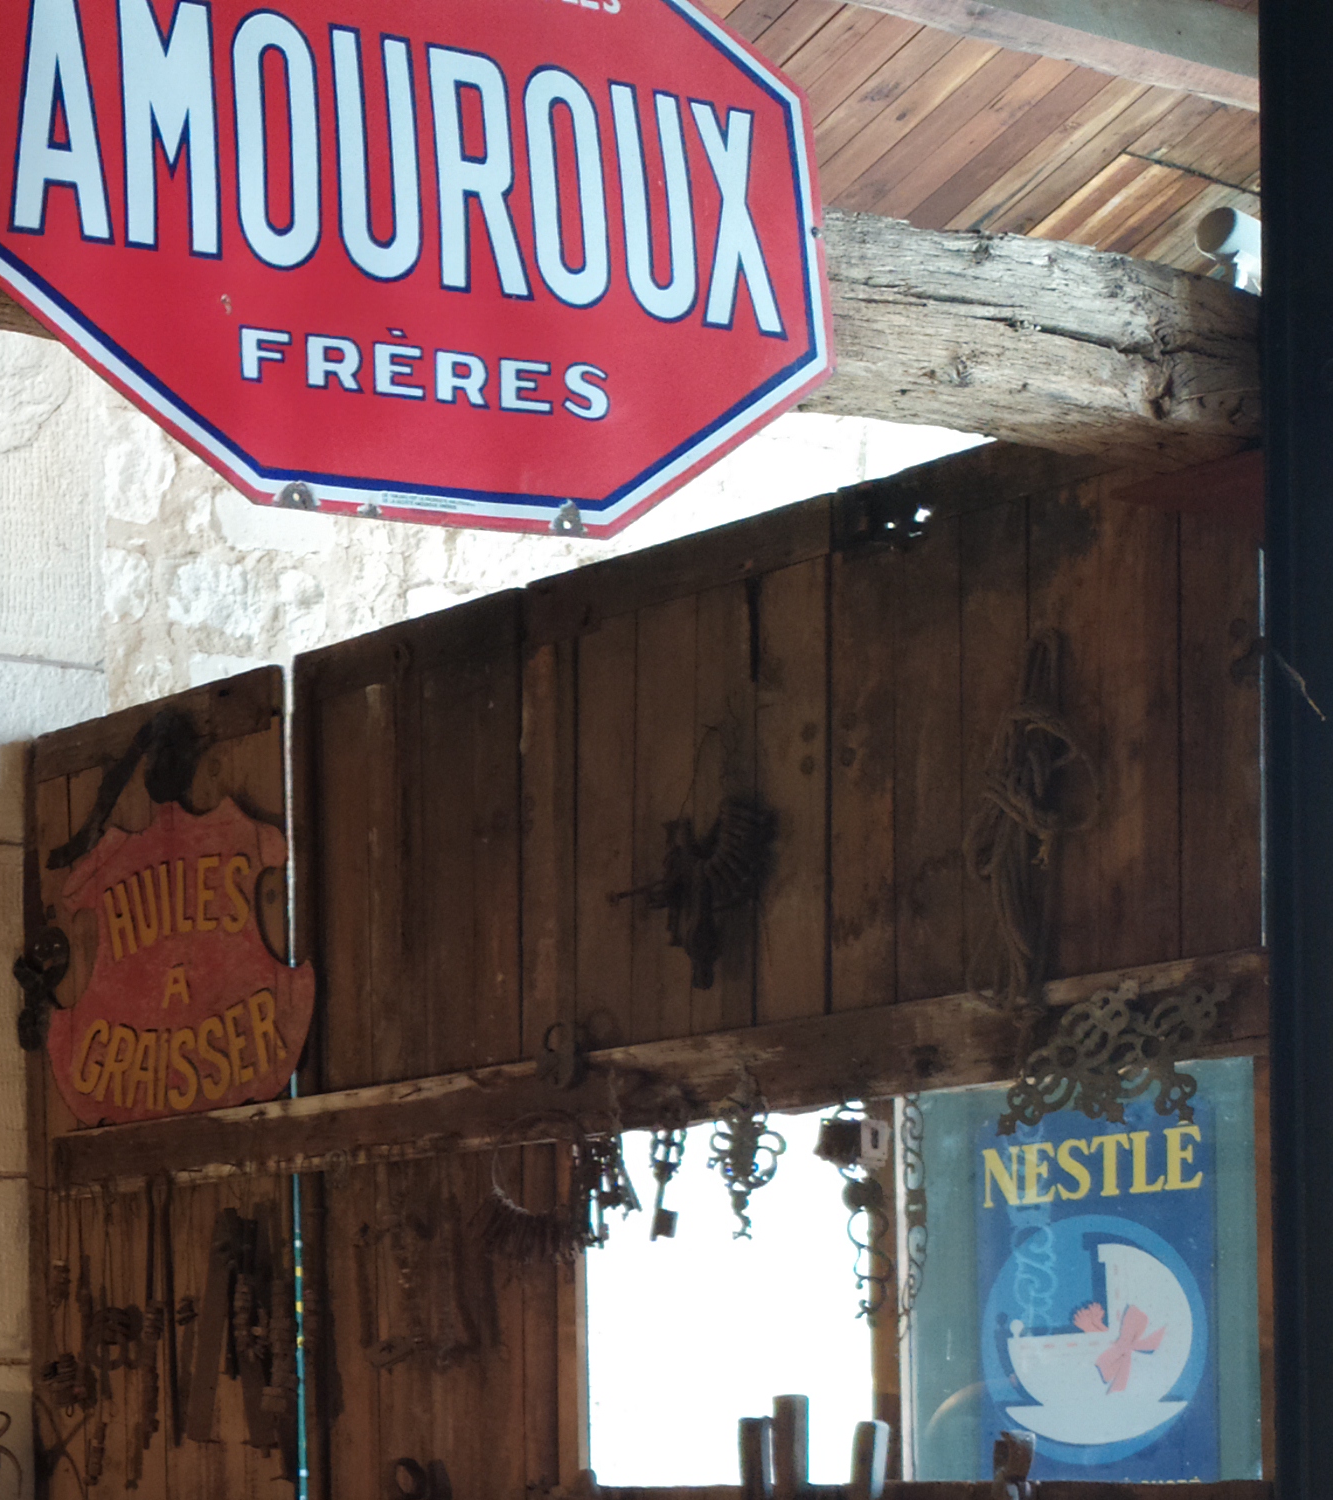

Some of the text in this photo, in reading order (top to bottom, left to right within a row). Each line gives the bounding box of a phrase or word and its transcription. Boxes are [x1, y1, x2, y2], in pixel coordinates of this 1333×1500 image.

[10, 0, 787, 339] AMOUROUX
[240, 328, 610, 422] FRÈRES
[102, 852, 251, 962] HUILES
[72, 988, 287, 1111] GRAISSER
